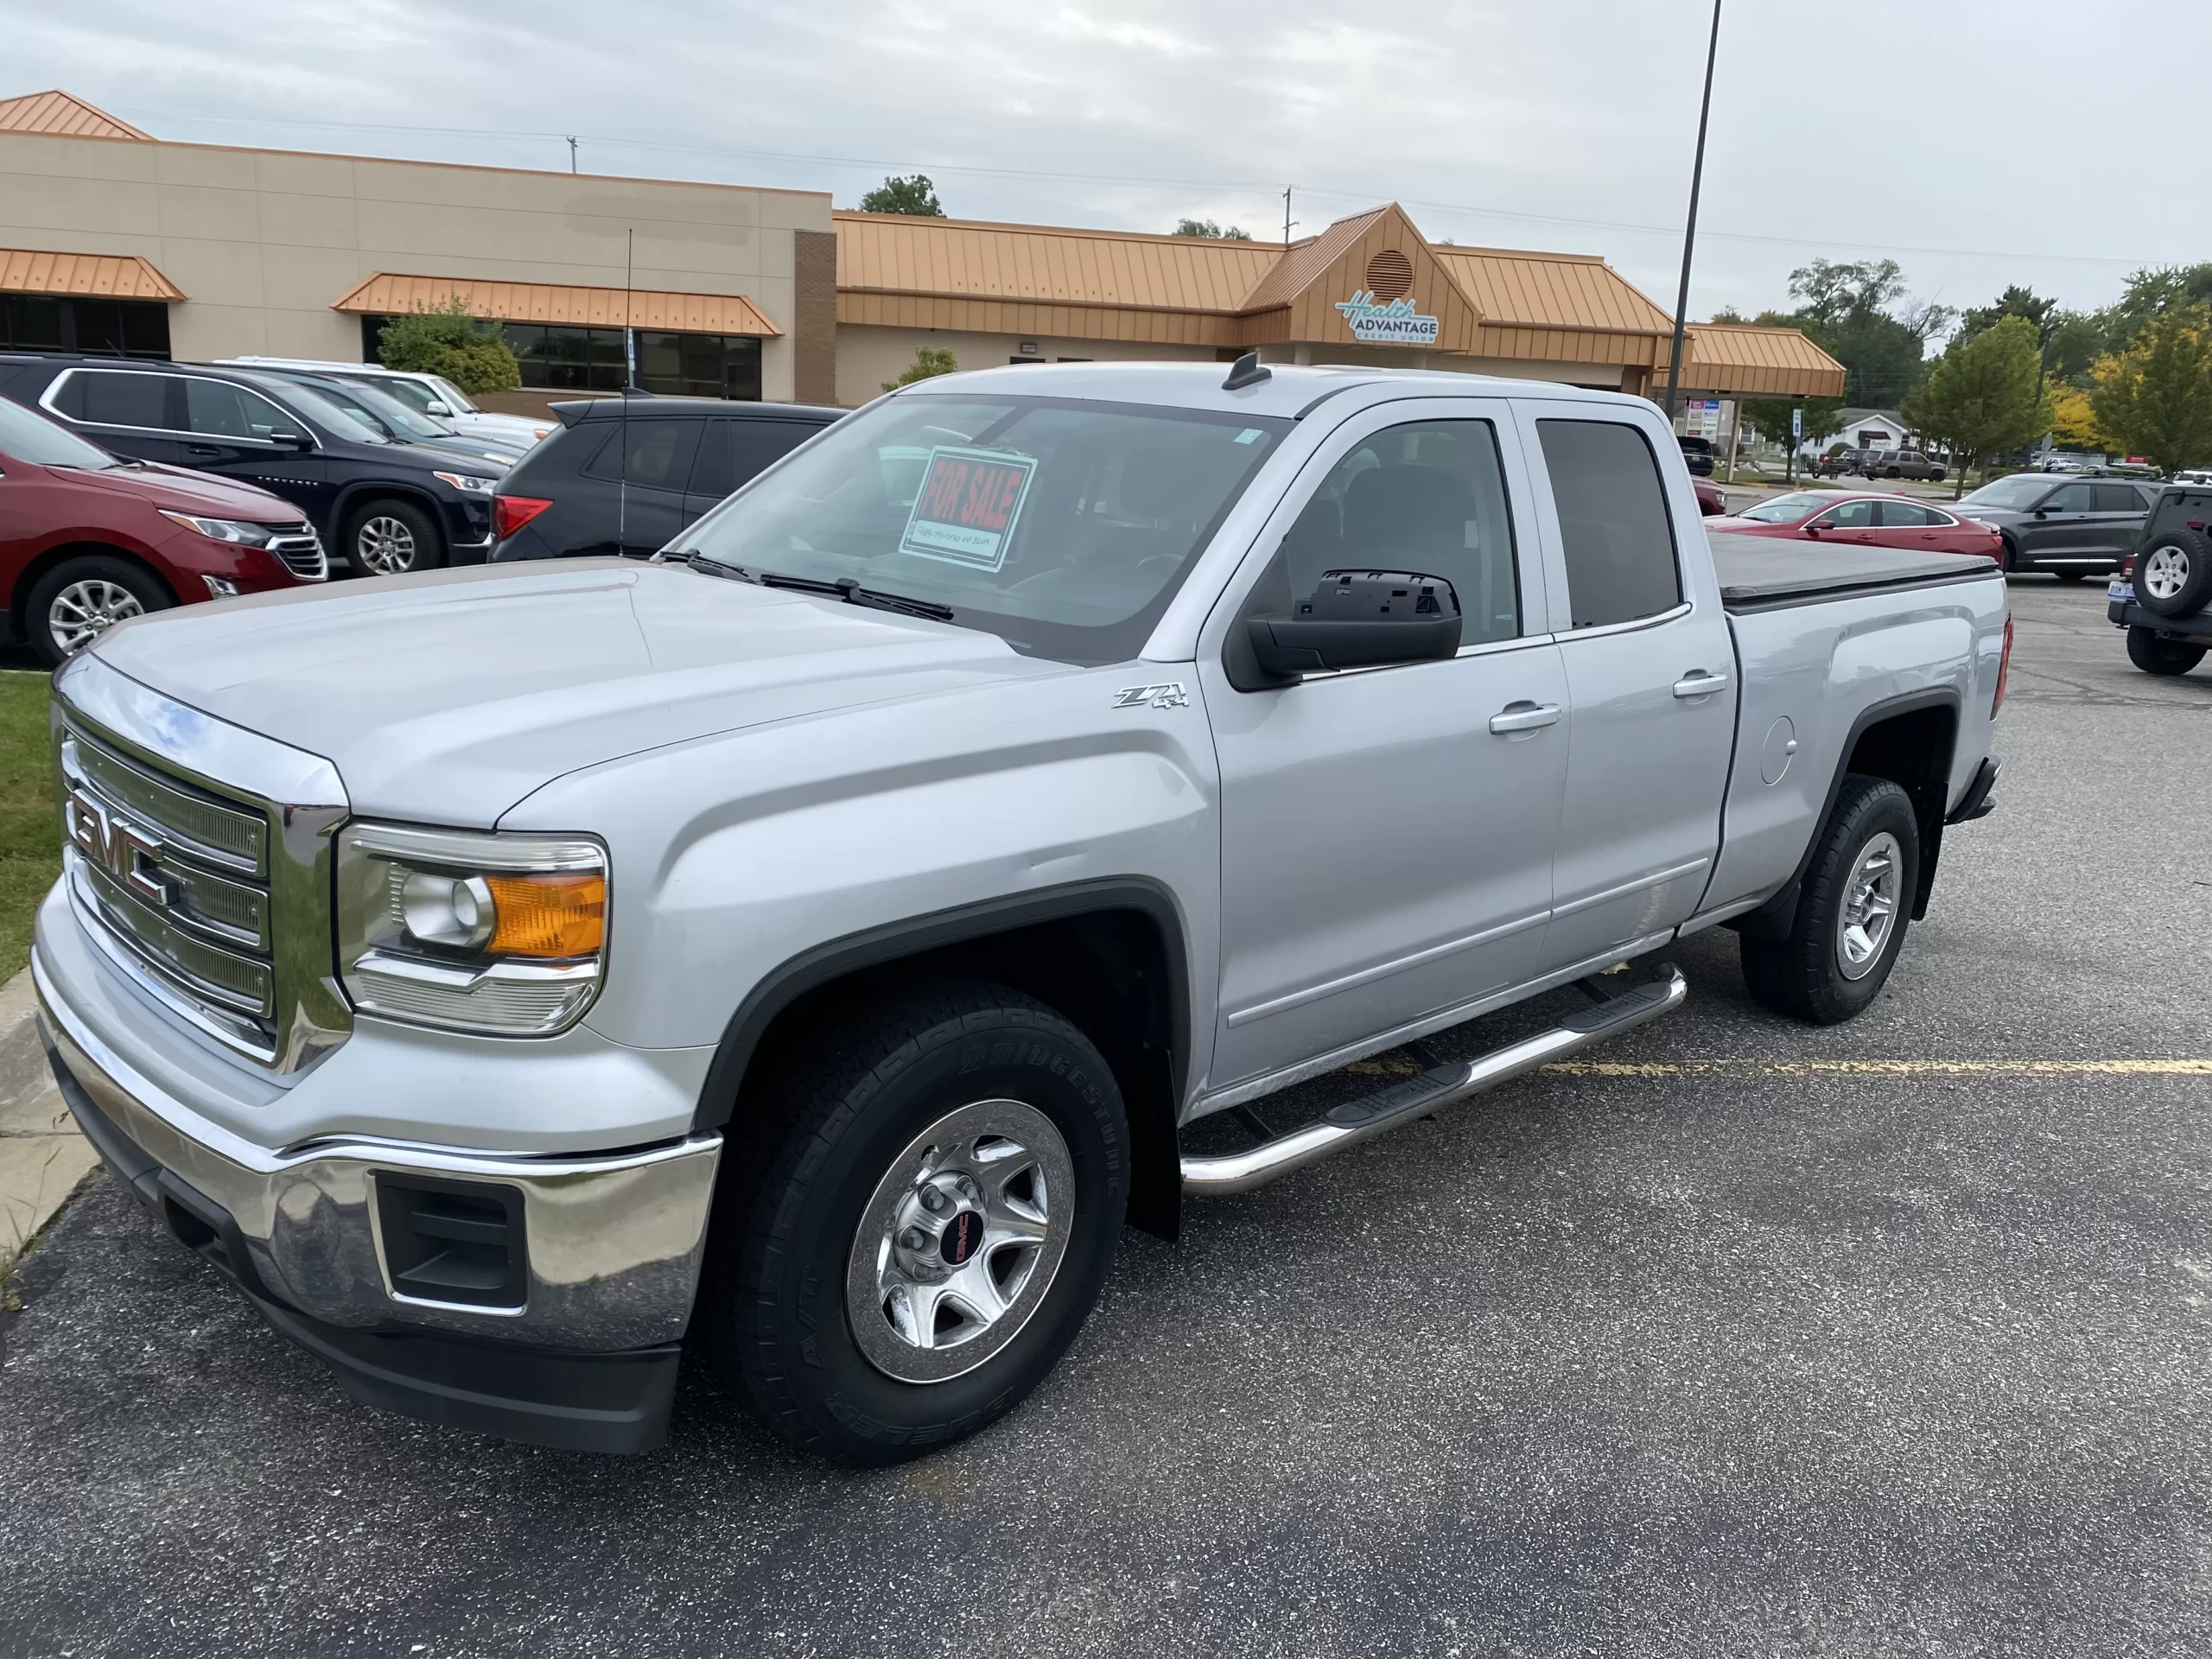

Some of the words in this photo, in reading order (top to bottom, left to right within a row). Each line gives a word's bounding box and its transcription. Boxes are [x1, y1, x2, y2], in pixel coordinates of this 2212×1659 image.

[1336, 291, 1435, 327] Health
[1355, 319, 1438, 334] ADVANTAGE
[919, 460, 969, 522] FOR
[960, 465, 1022, 530] SALE
[1111, 681, 1186, 709] Z71
[67, 788, 178, 906] GMC
[956, 1213, 969, 1262] GMC
